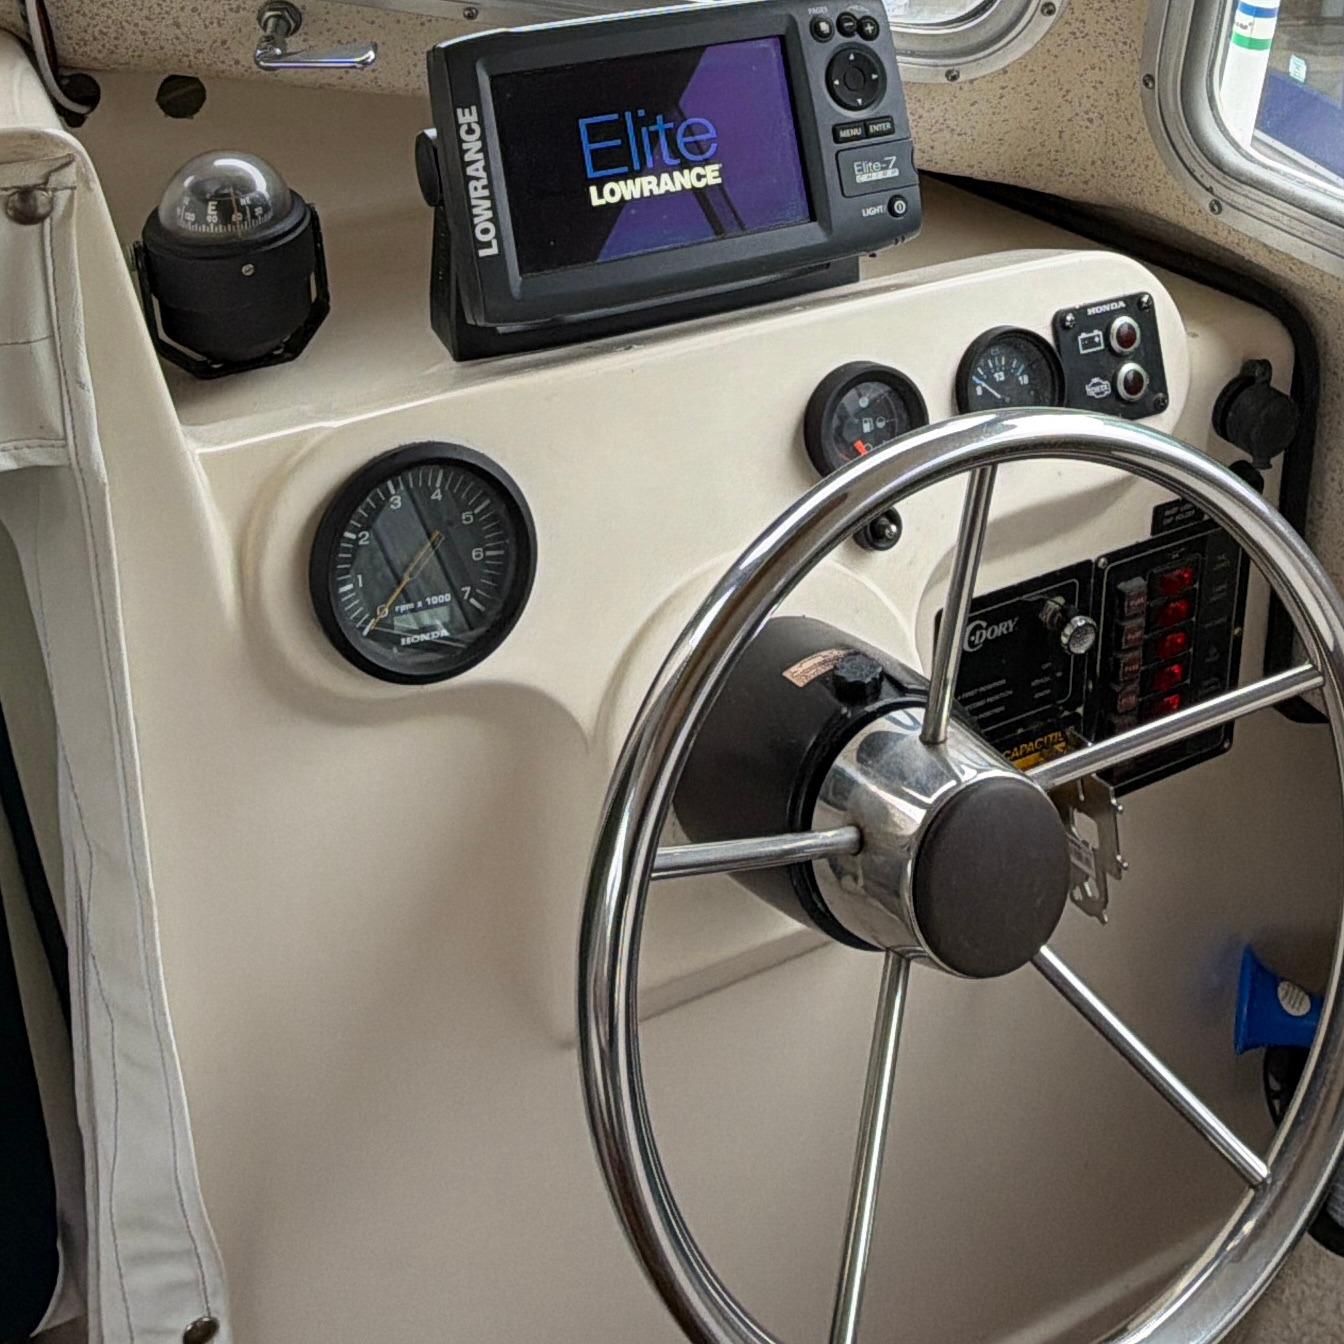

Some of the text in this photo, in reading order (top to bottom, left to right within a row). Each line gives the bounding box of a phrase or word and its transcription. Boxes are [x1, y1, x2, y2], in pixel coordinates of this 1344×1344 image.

[839, 127, 862, 138] MENU
[869, 122, 892, 134] ENTER
[578, 109, 719, 179] Elite
[854, 155, 897, 175] Elite-7
[457, 105, 499, 258] LOWRANCE
[589, 164, 722, 206] LOWRANCE
[207, 201, 218, 215] E
[207, 215, 218, 223] 90
[1087, 300, 1126, 316] HONDA
[431, 489, 443, 501] 4
[390, 496, 402, 509] 3
[461, 511, 474, 525] 5
[358, 531, 370, 545] 2
[472, 548, 484, 561] 6
[357, 574, 363, 587] 1
[461, 586, 471, 600] 7
[395, 601, 415, 614] rpm
[425, 593, 452, 606] 1000
[400, 628, 450, 646] HONDA
